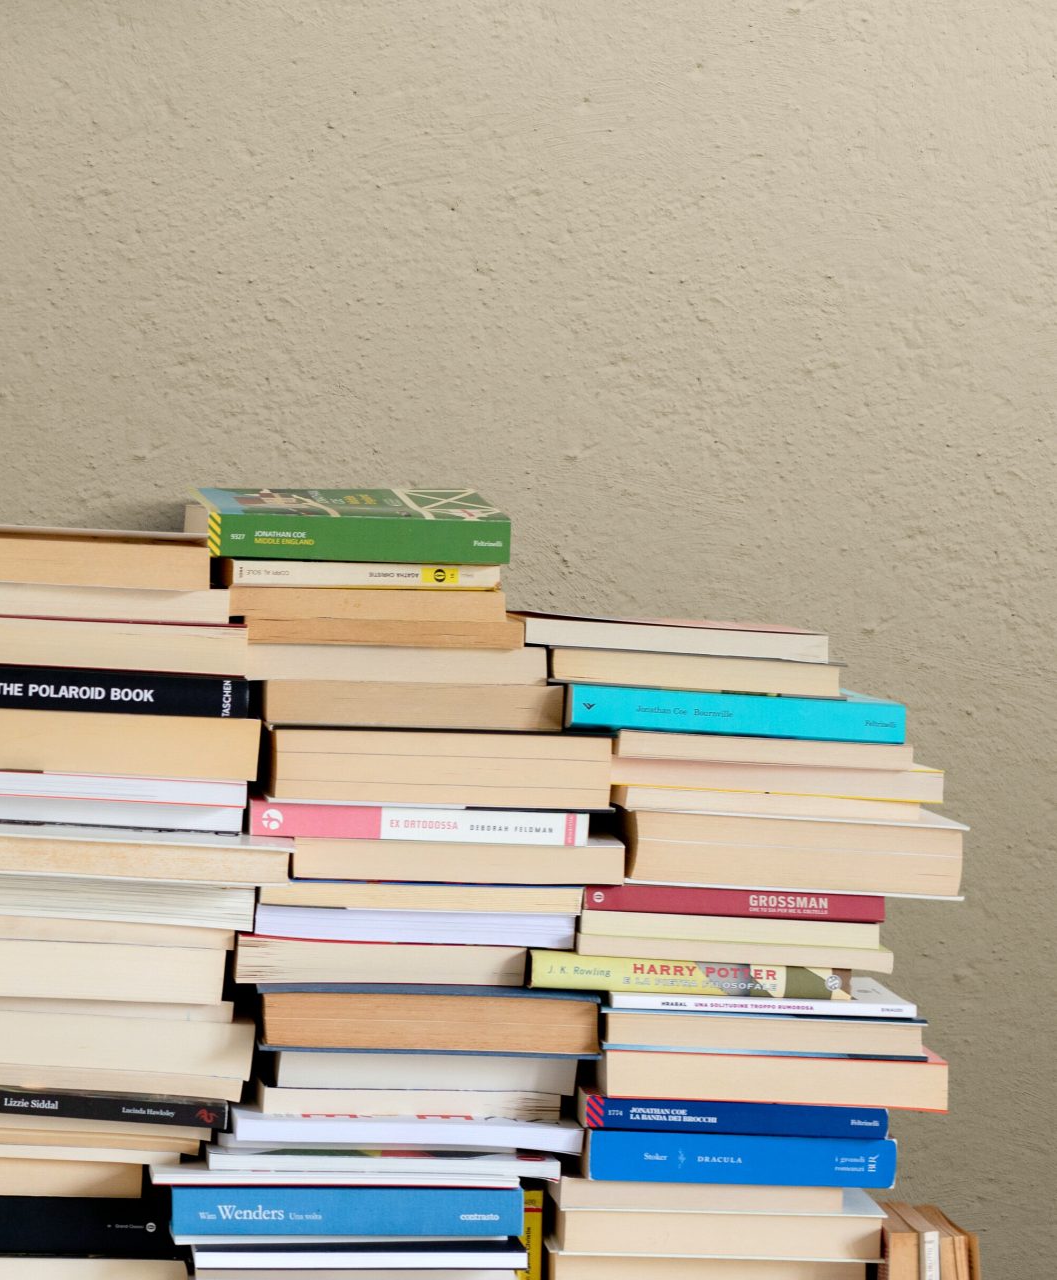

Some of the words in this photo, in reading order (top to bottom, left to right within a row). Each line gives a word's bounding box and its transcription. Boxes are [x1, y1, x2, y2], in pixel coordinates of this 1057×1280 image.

[254, 530, 292, 538] JONATHAN
[281, 538, 314, 546] ENGLAND
[28, 684, 105, 700] POLAROID
[110, 688, 155, 702] BOOK
[221, 680, 232, 717] TASCHEN
[636, 705, 671, 714] Jonathan
[673, 707, 687, 715] Coe
[693, 708, 733, 718] Bournville
[389, 819, 400, 828] EX
[404, 820, 458, 830] ORTODOSSA
[470, 824, 509, 832] DEBORAH
[514, 826, 554, 834] FELDMAN
[749, 894, 829, 909] GROSSMAN
[547, 965, 555, 974] J.
[573, 966, 611, 977] Rowling
[633, 963, 697, 977] HARRY
[705, 966, 777, 980] POTTER
[4, 1097, 30, 1108] Lizzie
[30, 1099, 59, 1110] Siddal
[630, 1107, 670, 1115] JONATHAN
[671, 1108, 688, 1116] COE
[641, 1114, 668, 1122] BANDA
[682, 1116, 718, 1124] BROCCHI
[644, 1152, 668, 1161] Stoker
[697, 1156, 743, 1164] DRACULA
[199, 1212, 217, 1220] Wim
[217, 1204, 285, 1221] Wenders
[289, 1212, 304, 1220] Una
